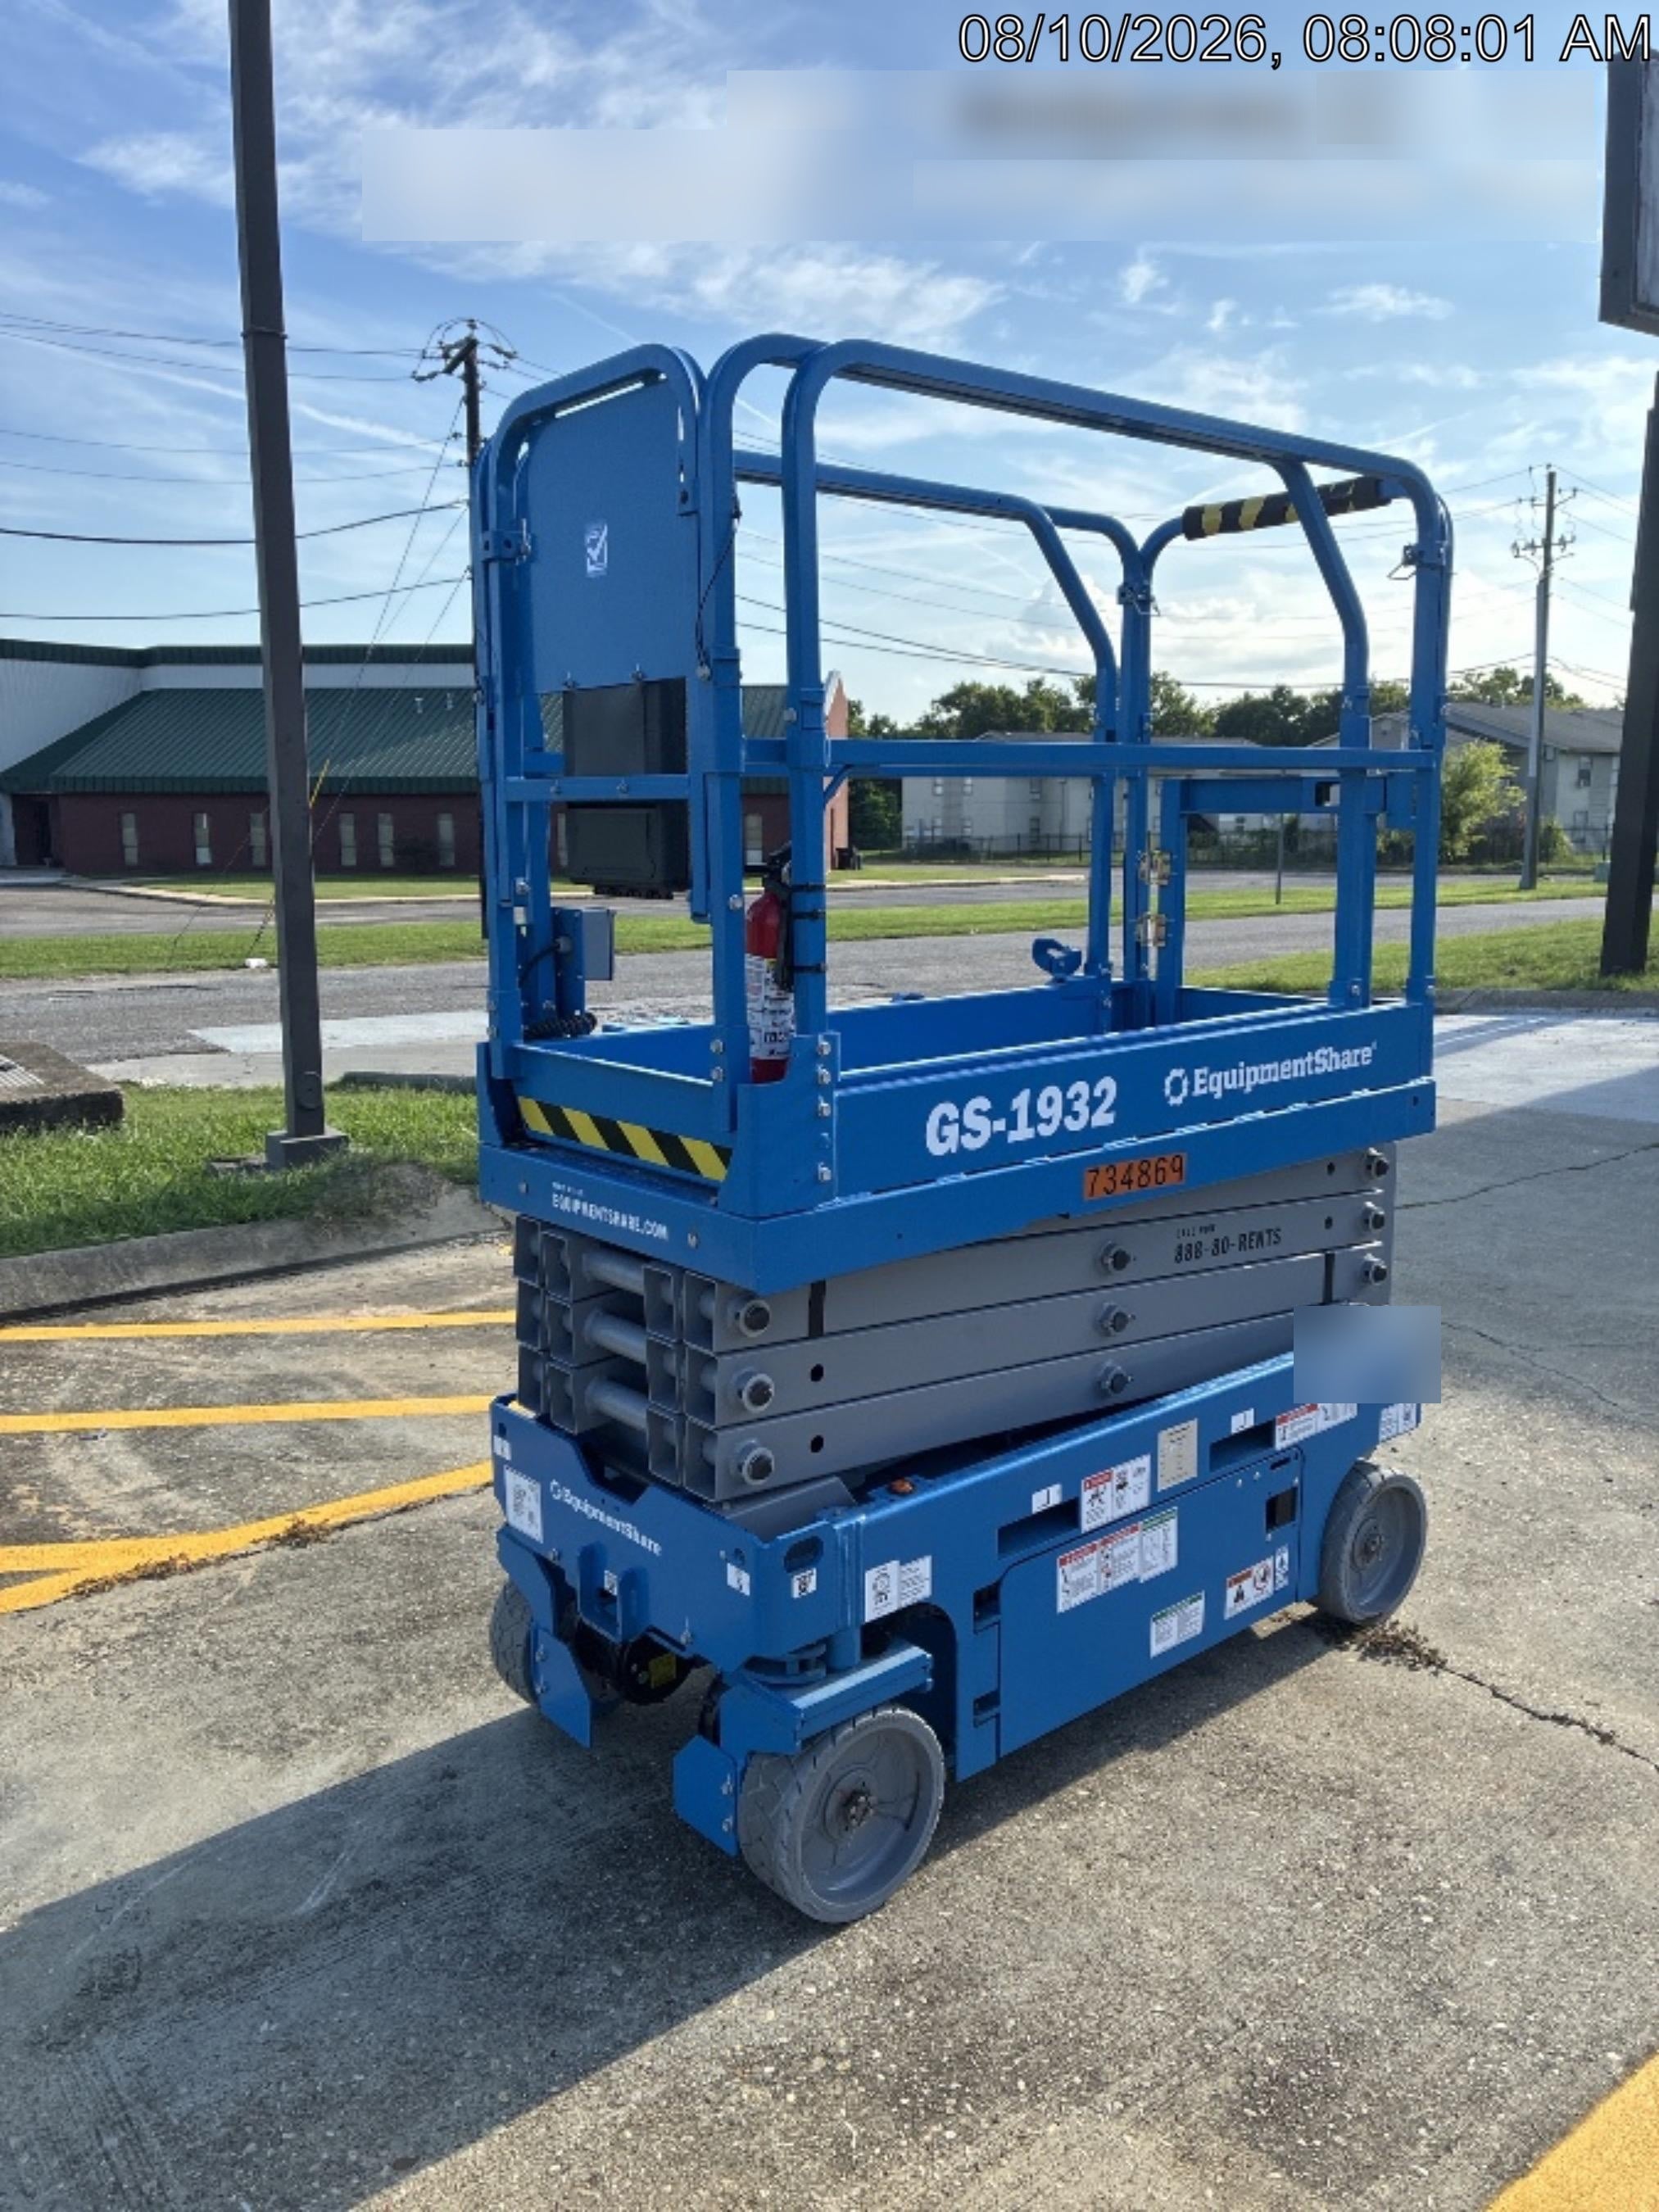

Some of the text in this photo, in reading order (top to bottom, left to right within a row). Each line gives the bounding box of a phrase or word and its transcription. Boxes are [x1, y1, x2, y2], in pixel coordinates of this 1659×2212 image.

[1192, 1046, 1373, 1099] EquipmentShare
[926, 1076, 1117, 1157] GS-1932
[1087, 1154, 1184, 1198] 734869
[562, 1486, 663, 1557] EquipmentShare
